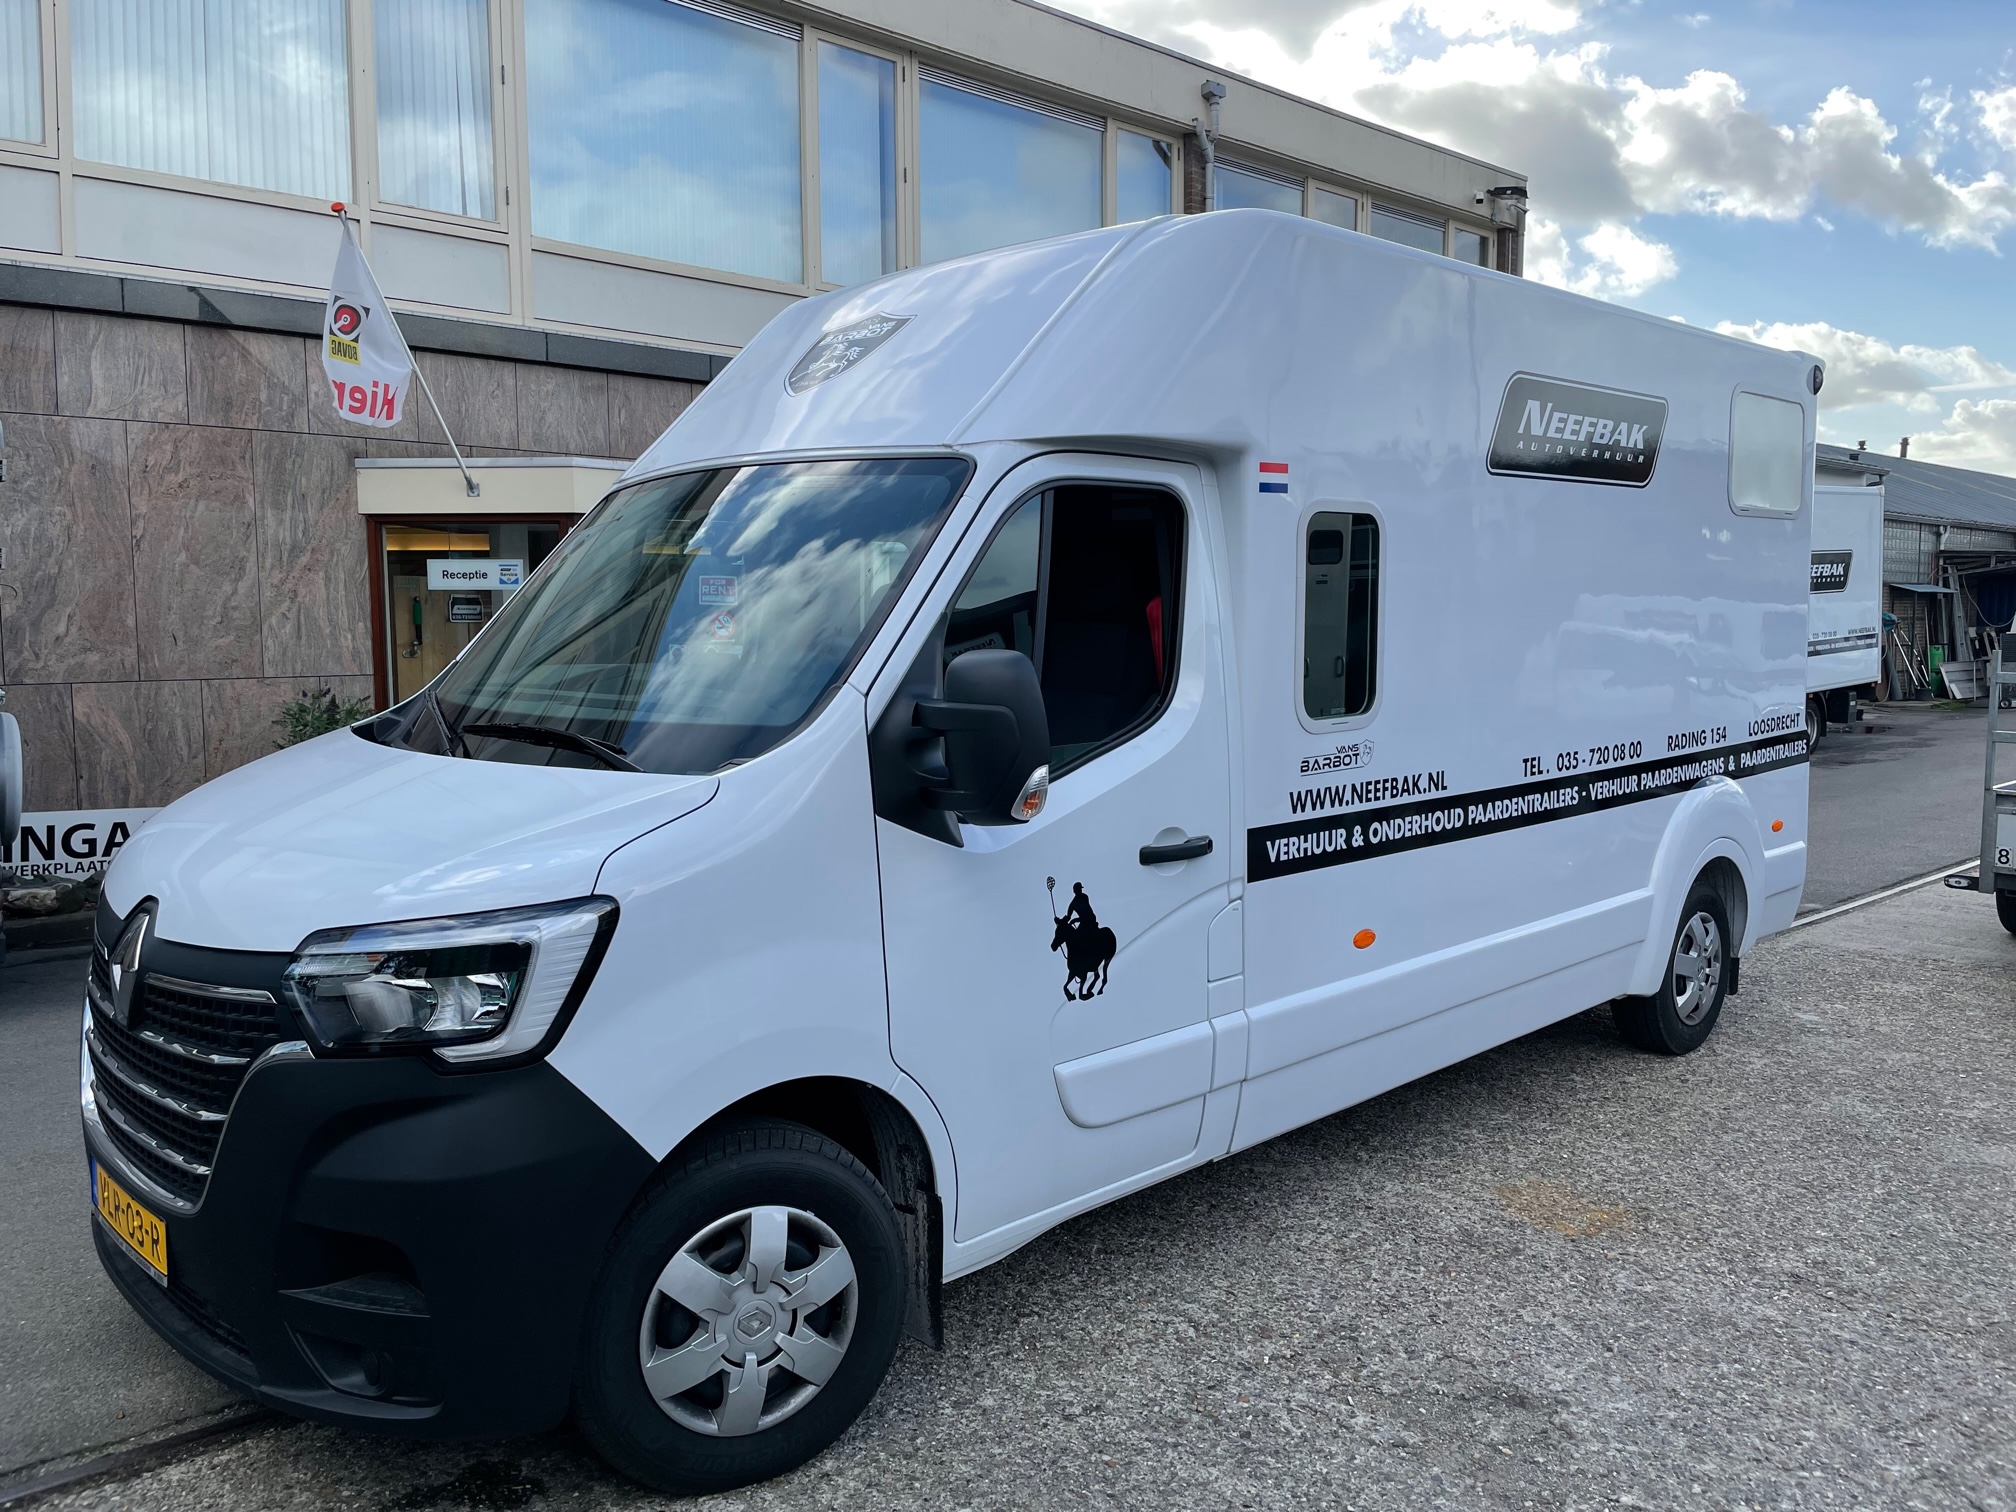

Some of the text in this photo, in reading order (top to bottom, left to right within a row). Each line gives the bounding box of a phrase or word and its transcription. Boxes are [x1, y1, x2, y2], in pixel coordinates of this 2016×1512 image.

[1517, 399, 1649, 449] NEEFBAK
[1516, 440, 1645, 464] AUTOVERHUUR
[442, 569, 488, 581] Receptie
[702, 585, 735, 595] RENT
[1336, 743, 1360, 754] VANS
[1289, 770, 1448, 814] WWW.NEEFBAK.NL
[1556, 751, 1579, 773] 035
[1612, 742, 1626, 762] 08
[1628, 740, 1642, 759] 00
[1667, 729, 1707, 752] RADING
[1710, 726, 1727, 744] 154
[1748, 712, 1800, 737] LOOSDRECHT
[1300, 753, 1360, 773] BARBOT
[1266, 828, 1348, 863] VERHUUR
[1351, 825, 1364, 848] &
[1368, 807, 1464, 844] ONDERHOUD
[1467, 786, 1579, 826] PAARDENTRAILERS
[1589, 774, 1638, 800] VERHUUR
[1640, 756, 1725, 790] PAARDENWAGENS
[1728, 757, 1736, 771] &
[1740, 739, 1807, 769] PAARDENTRAILERS
[0, 821, 131, 863] INGA
[1997, 848, 2010, 865] 8
[3, 860, 111, 877] WERKPLAAT
[99, 1171, 162, 1264] VLR-03-R
